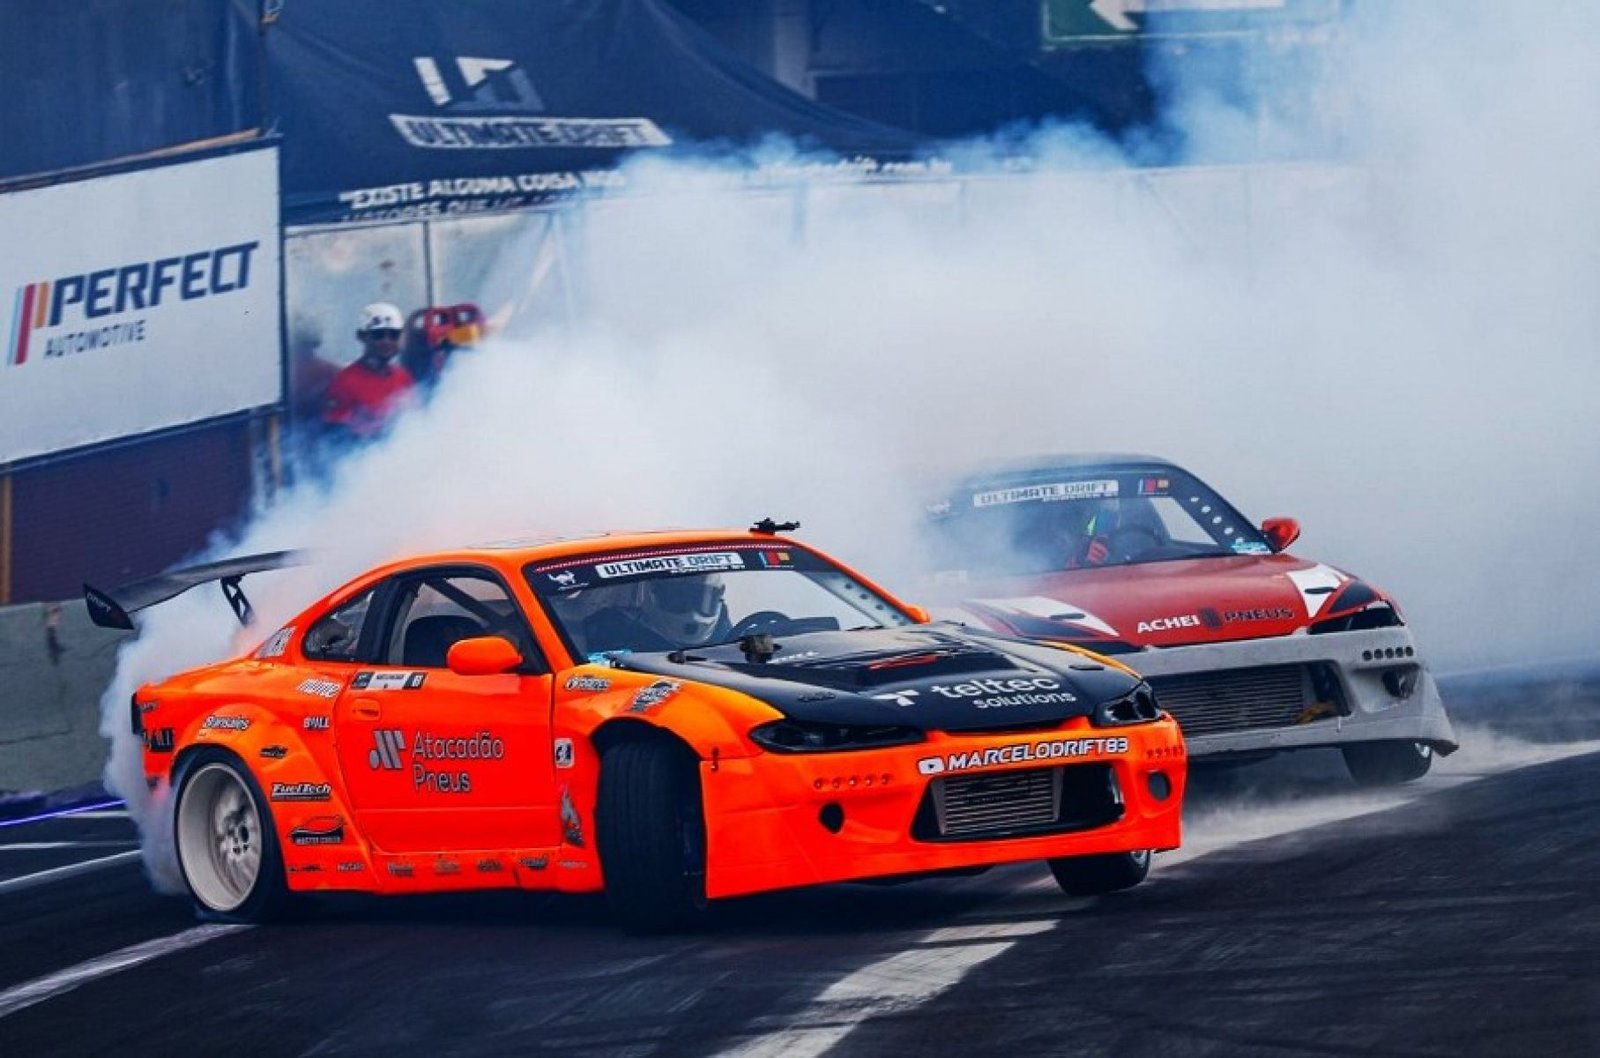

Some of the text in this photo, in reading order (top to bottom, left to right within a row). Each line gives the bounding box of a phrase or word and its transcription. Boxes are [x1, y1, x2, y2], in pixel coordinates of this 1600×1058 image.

[49, 241, 259, 327] PERFECT
[45, 319, 146, 359] AUTOMOTIVE
[980, 485, 1061, 504] ULTIMATE
[1064, 480, 1108, 495] DRIFT
[604, 557, 681, 576] ULTIMATE
[687, 553, 732, 568] DRIFT
[1136, 607, 1295, 634] ACHEI PNEUS
[930, 677, 1060, 698] teltec
[973, 692, 1077, 709] solutions
[411, 731, 505, 760] Atacadão
[948, 737, 1129, 770] MARCELODRIFT83
[272, 782, 332, 795] FuelTech
[412, 764, 472, 793] Pneus
